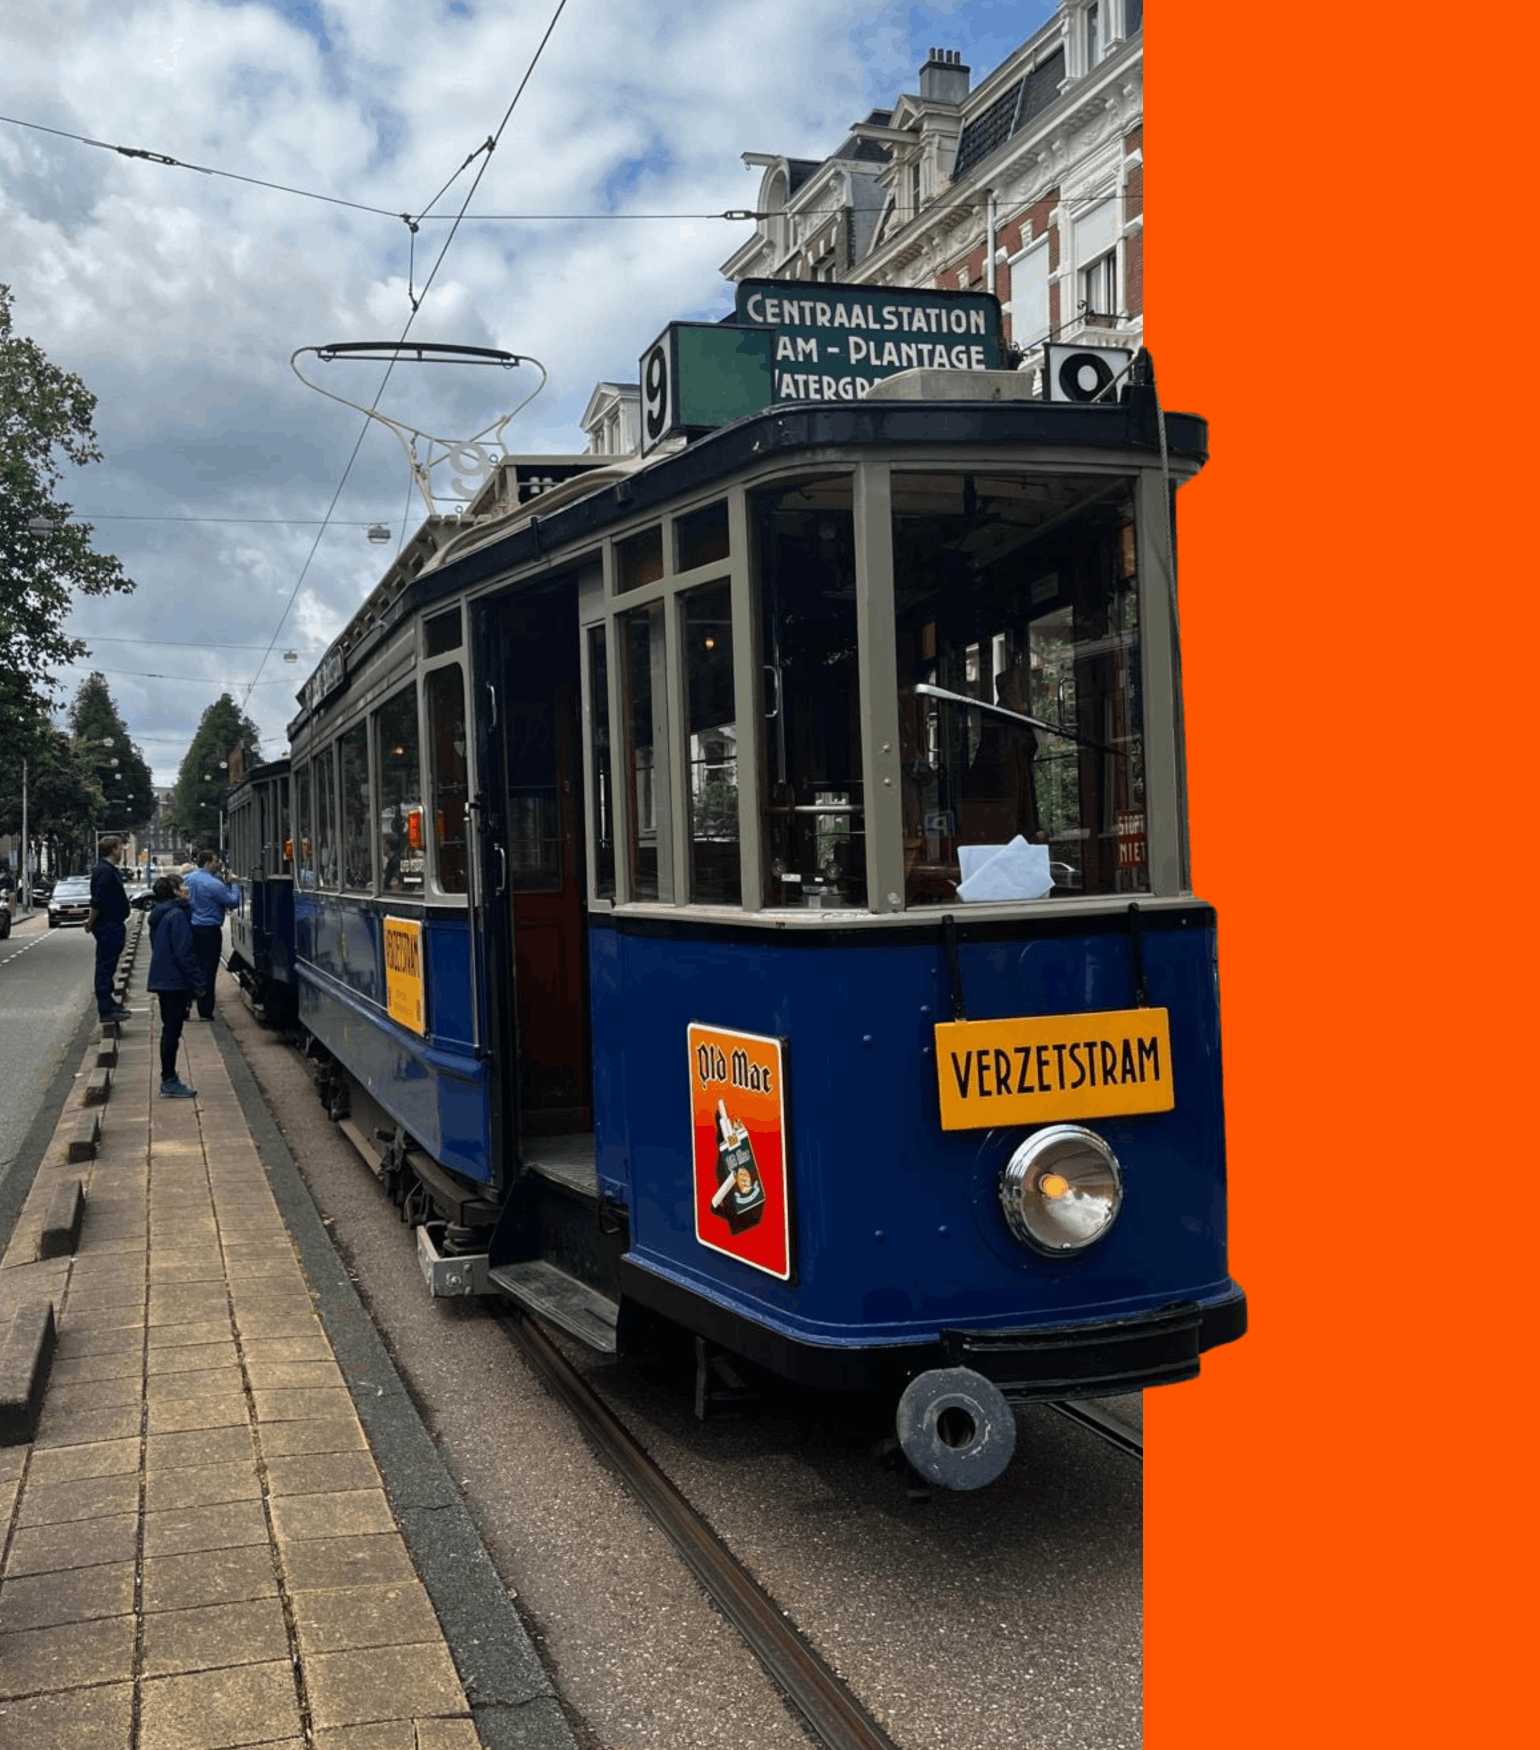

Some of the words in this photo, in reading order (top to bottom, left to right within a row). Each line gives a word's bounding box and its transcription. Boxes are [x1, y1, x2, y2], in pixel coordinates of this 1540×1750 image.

[747, 293, 986, 335] CENTRAALSTATION
[848, 336, 986, 369] PLANTAGE
[646, 345, 667, 440] 9
[774, 368, 882, 400] ATERGR
[450, 441, 491, 499] 9
[1119, 842, 1145, 863] NIET
[696, 1041, 728, 1090] Old
[730, 1046, 773, 1095] Mac
[951, 1036, 1160, 1099] VERZETSTRAM
